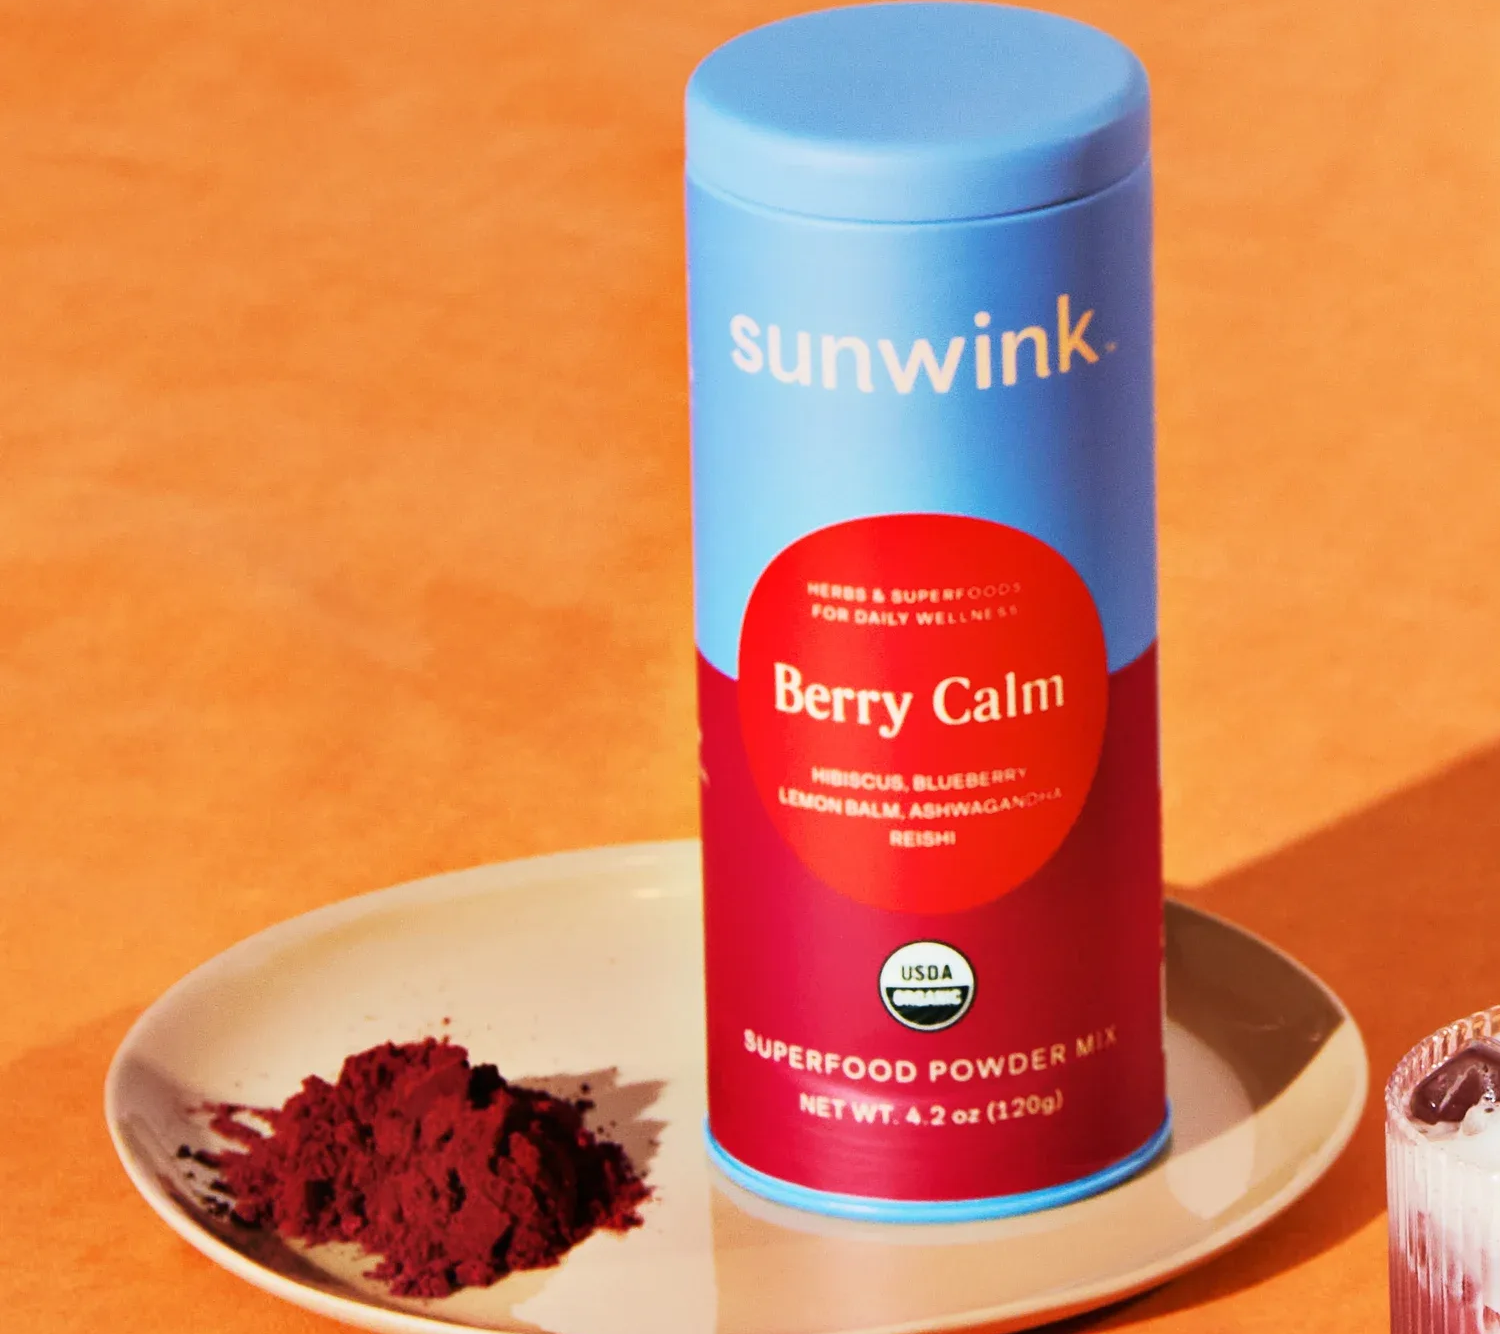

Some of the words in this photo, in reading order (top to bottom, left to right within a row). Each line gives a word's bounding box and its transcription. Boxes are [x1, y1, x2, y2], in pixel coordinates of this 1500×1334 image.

[730, 293, 1100, 395] sunwink
[807, 581, 867, 603] HERBS
[872, 587, 886, 604] &
[891, 581, 1023, 605] SUPERFOODS
[811, 602, 849, 622] FOR
[854, 608, 909, 627] DAILY
[915, 603, 1019, 627] WELLNESS
[774, 661, 914, 739] Berry
[932, 670, 1065, 726] Calm
[811, 765, 910, 794] HIBISCUS,
[778, 786, 843, 816] LEMON
[845, 799, 906, 821] BALM,
[889, 829, 956, 848] REISHI
[901, 964, 953, 981] USDA
[743, 1028, 918, 1084] SUPERFOOD
[928, 1041, 1067, 1084] POWDER
[1075, 1024, 1117, 1058] MIX
[799, 1092, 847, 1120] NET
[852, 1102, 900, 1126] WT.
[905, 1105, 946, 1126] 4.2
[951, 1107, 981, 1125] oz
[986, 1088, 1064, 1124] (120g)
